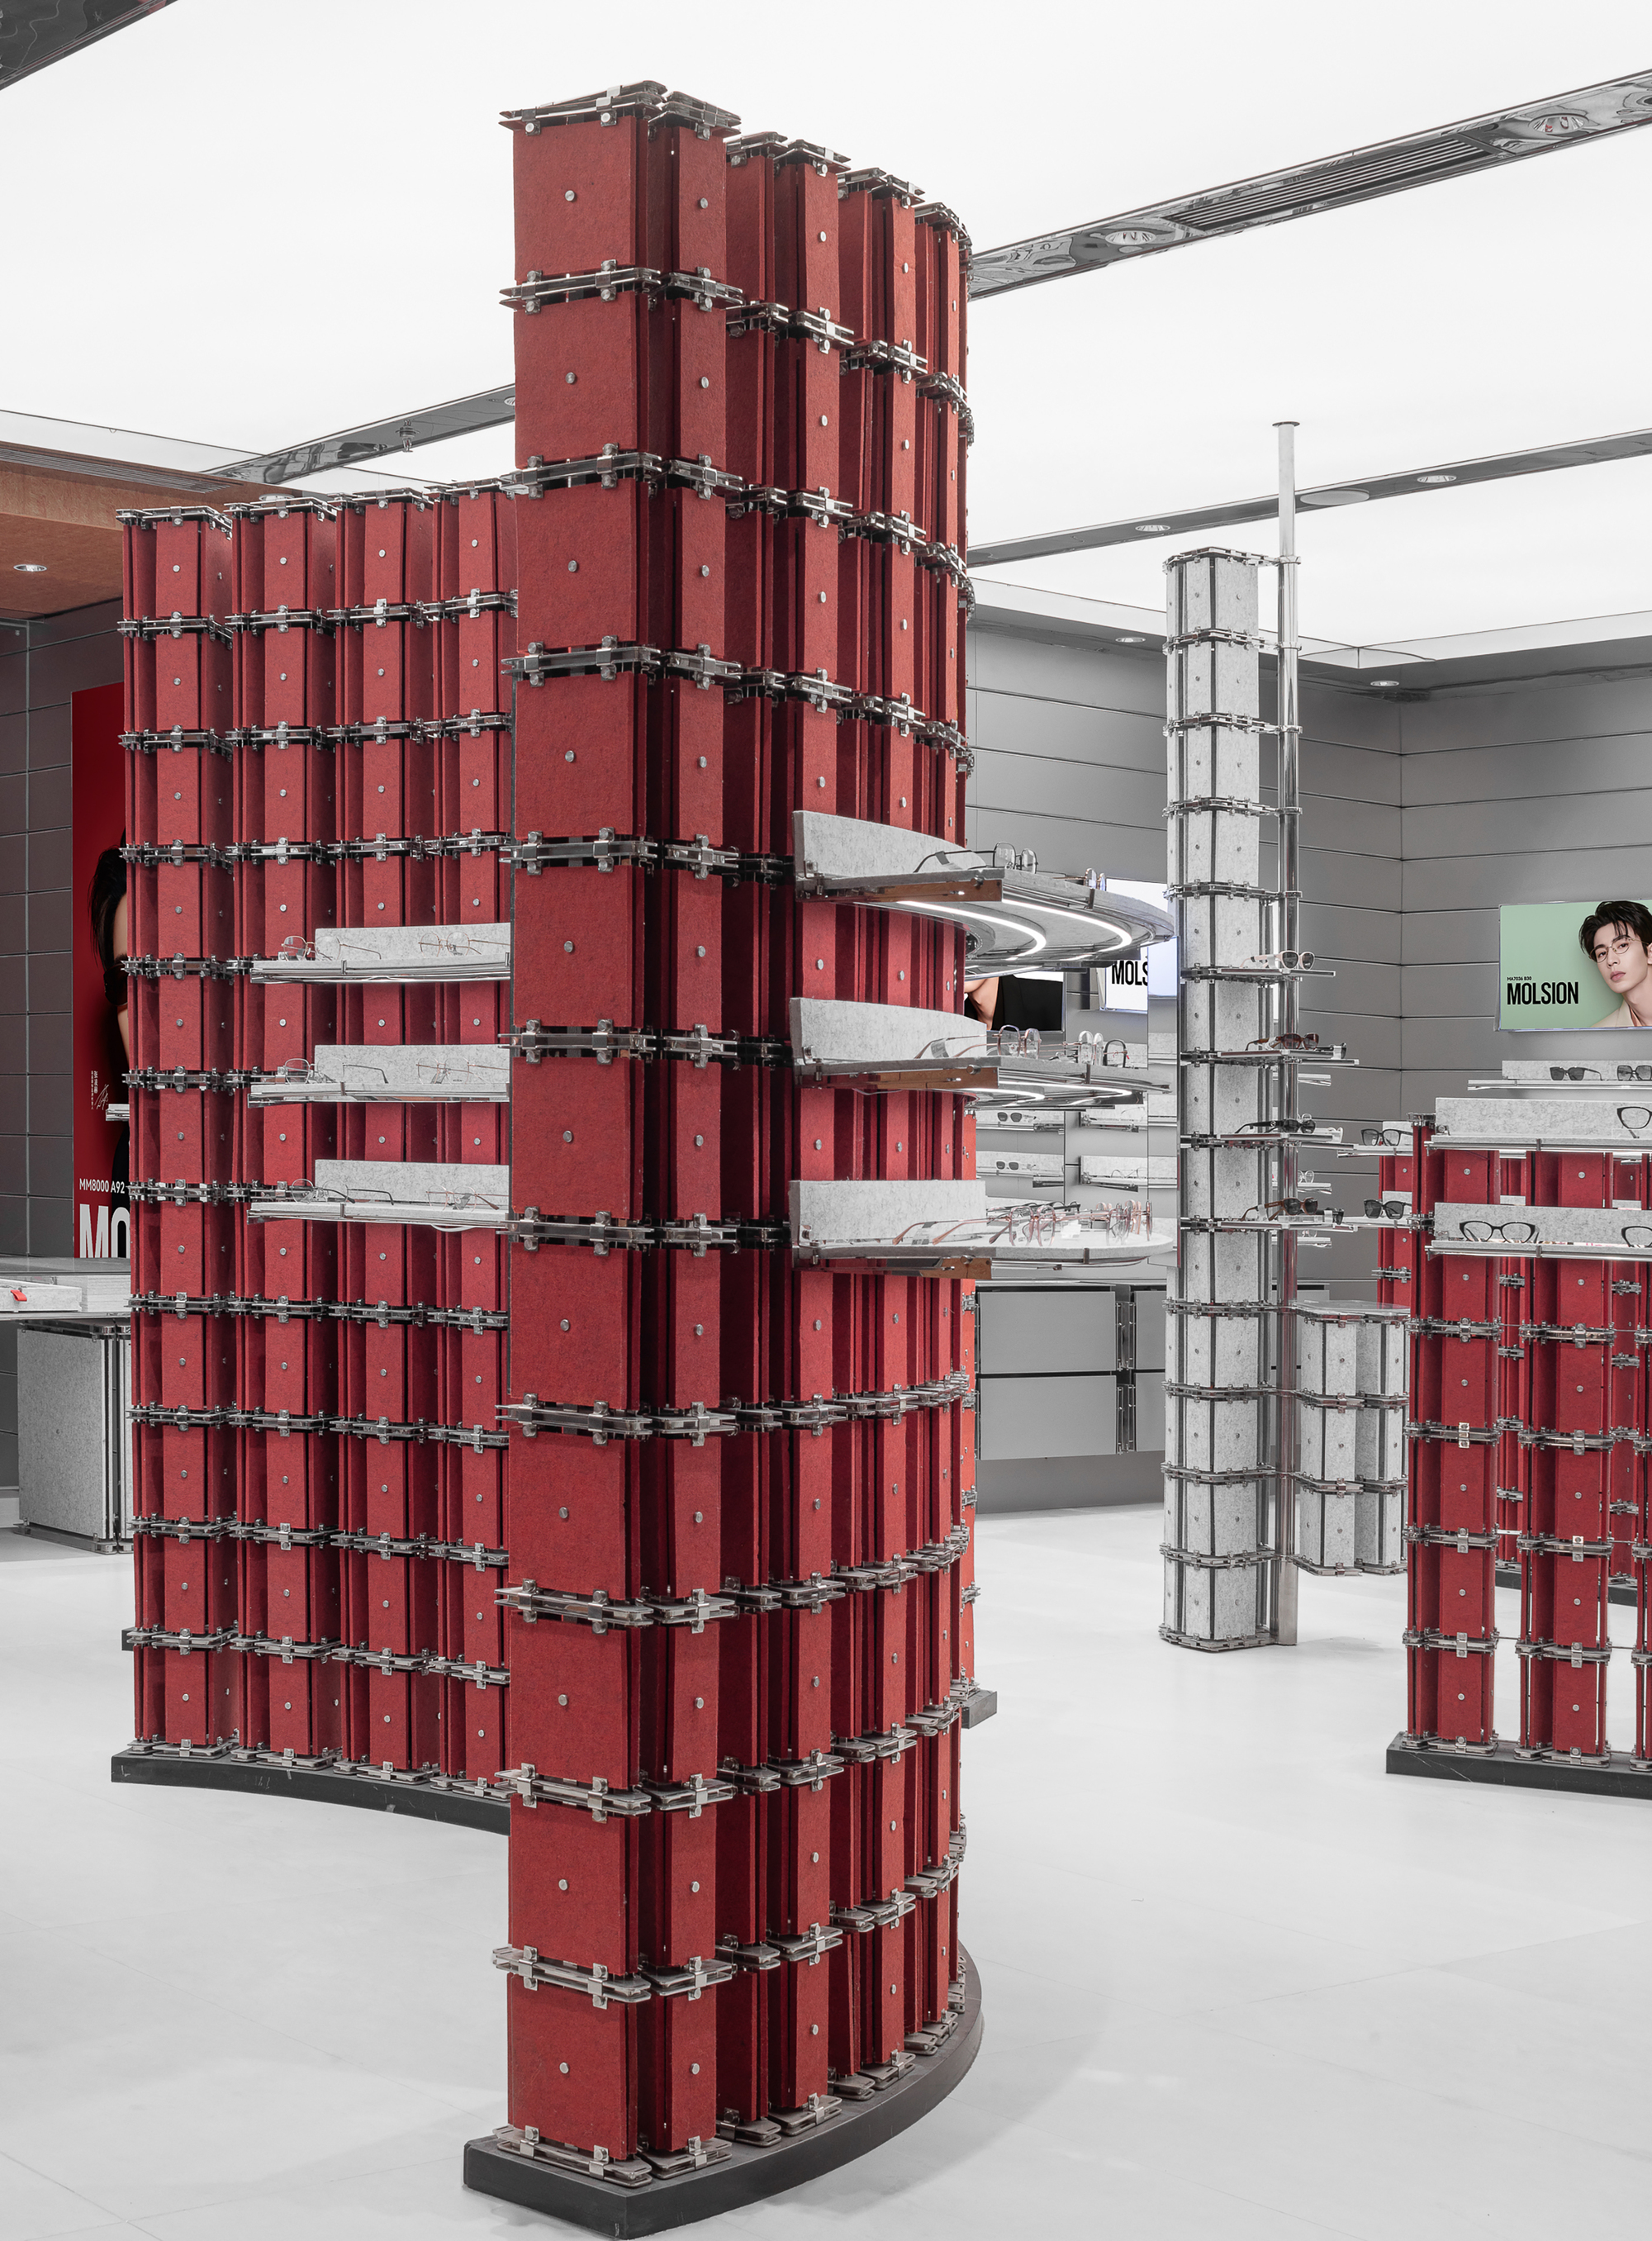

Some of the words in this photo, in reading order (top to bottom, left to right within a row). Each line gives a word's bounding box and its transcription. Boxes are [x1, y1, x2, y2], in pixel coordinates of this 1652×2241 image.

[1507, 981, 1578, 1005] MOLSION
[79, 1178, 110, 1193] MM8000
[110, 1180, 126, 1194] A92
